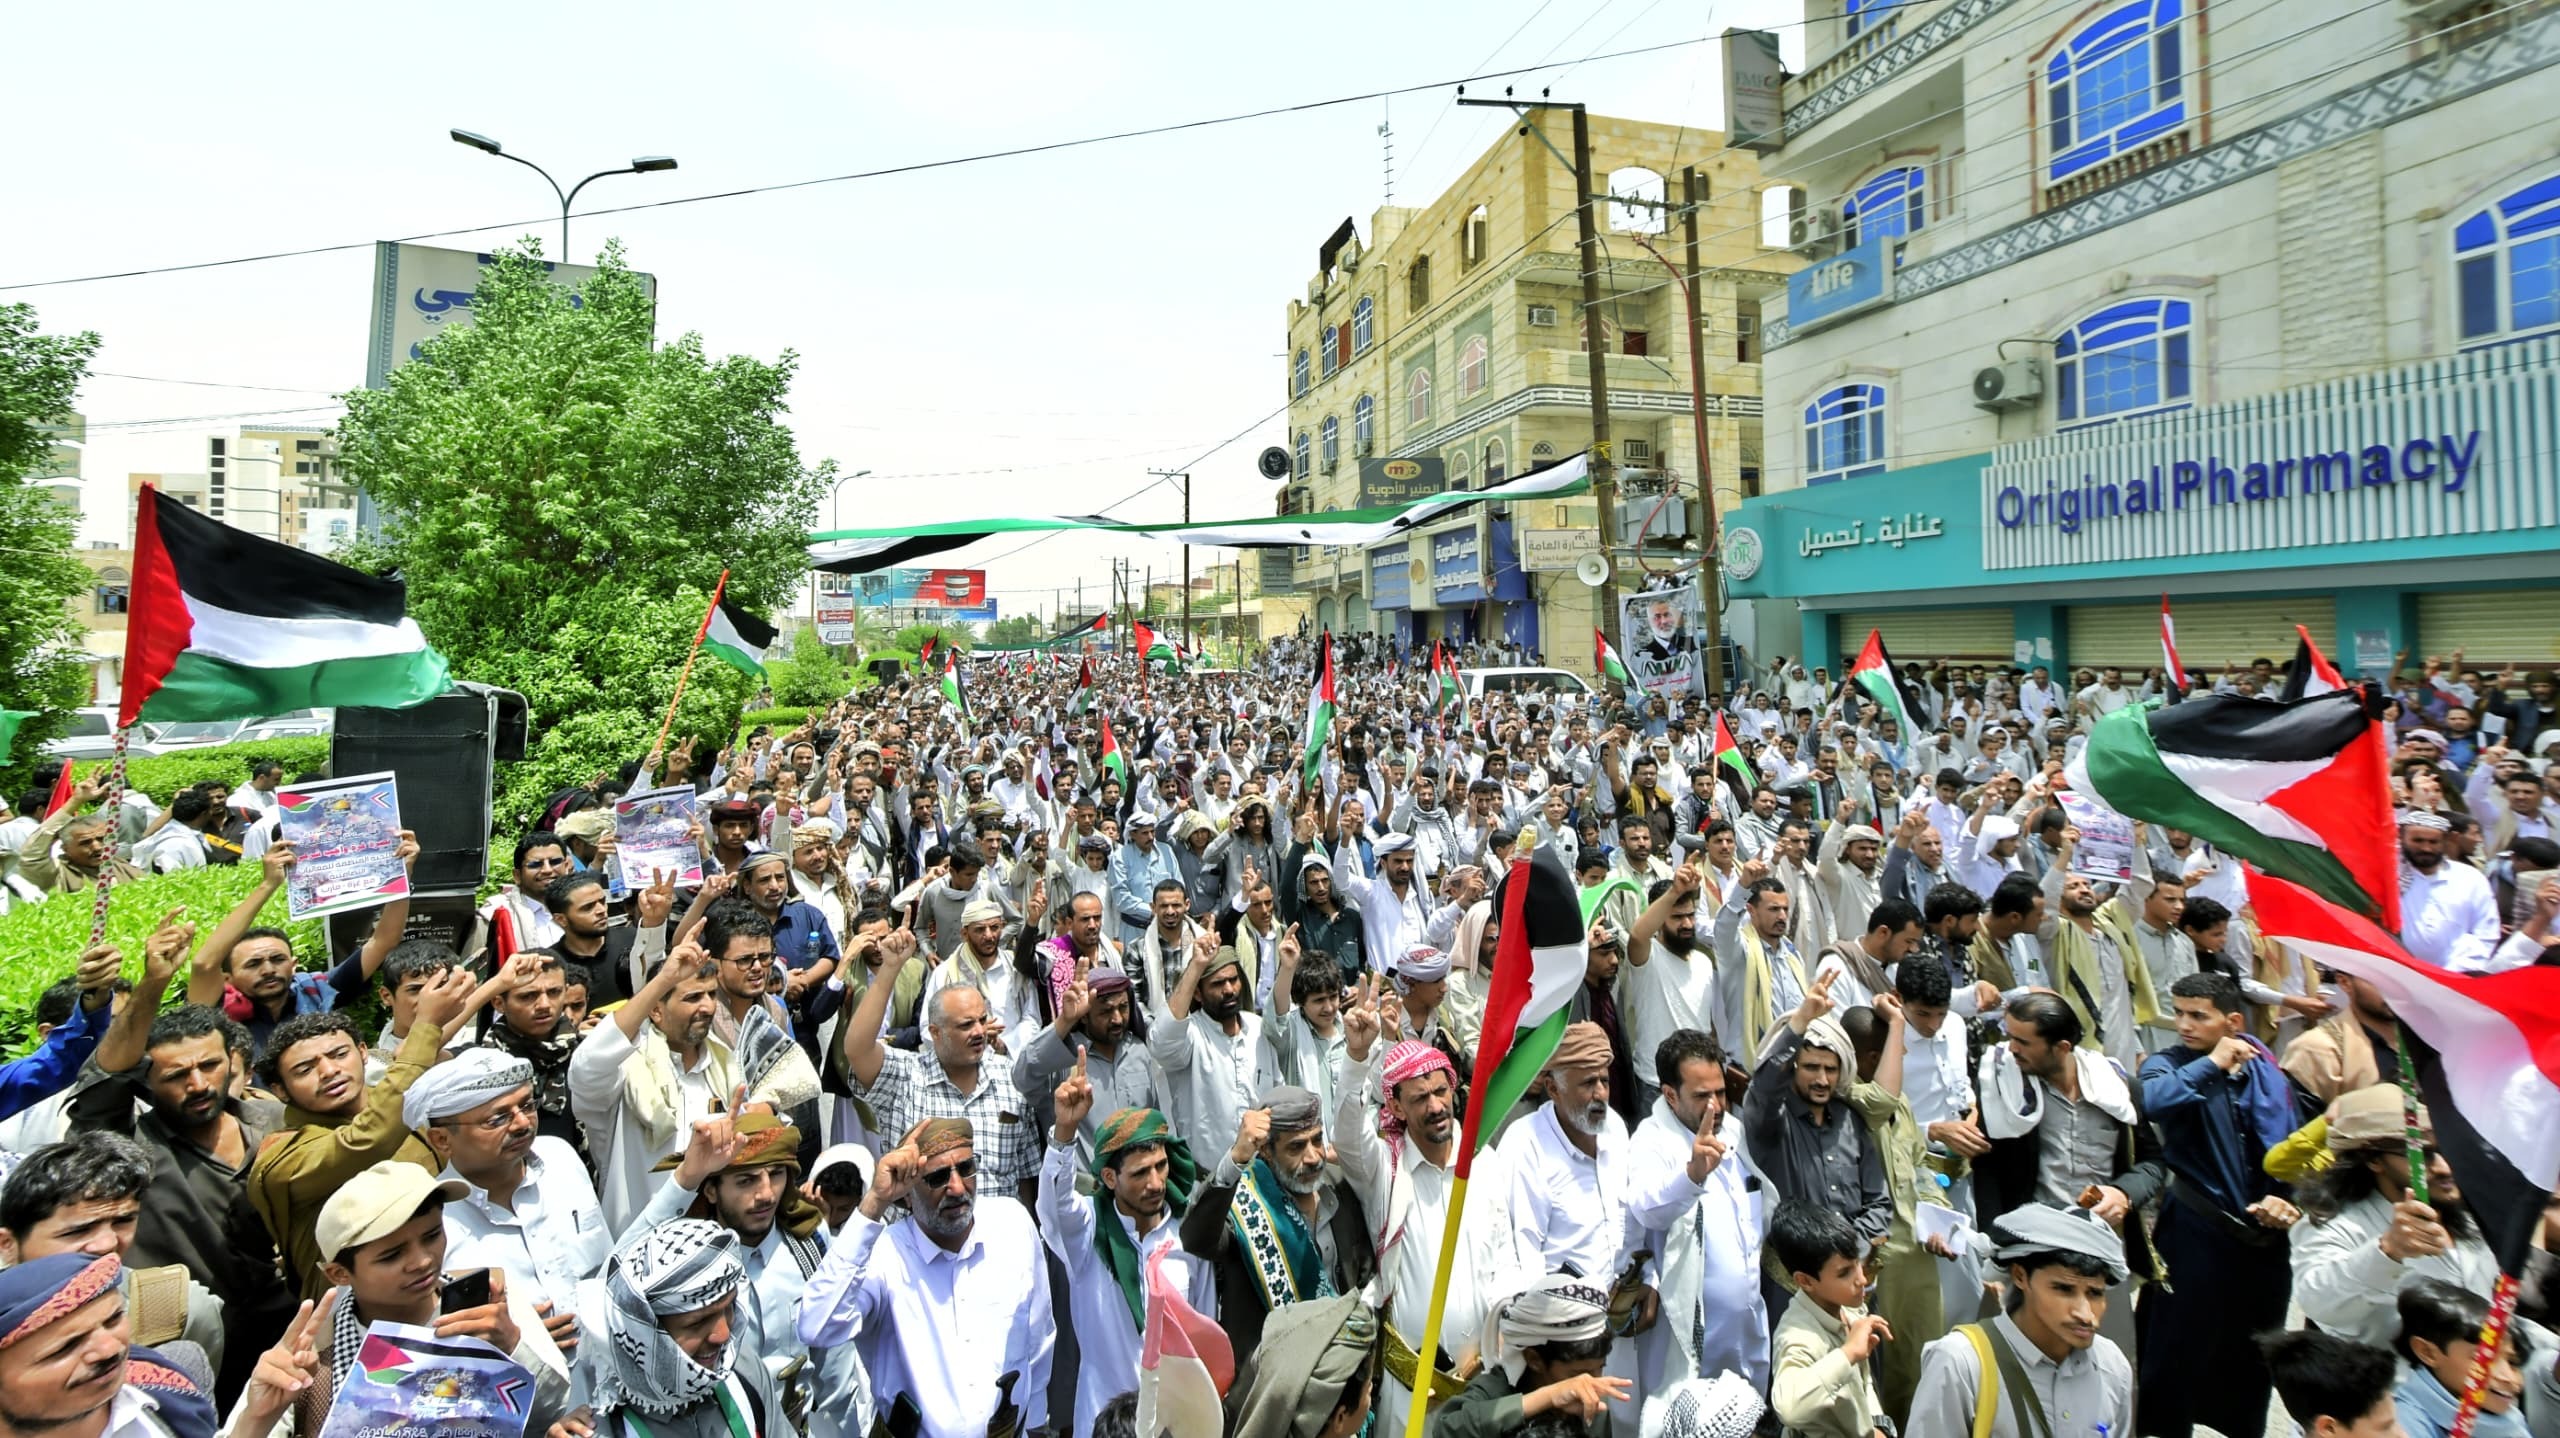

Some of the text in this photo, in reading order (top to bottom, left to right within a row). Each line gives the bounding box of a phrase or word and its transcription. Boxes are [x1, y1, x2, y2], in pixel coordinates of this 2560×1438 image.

[1997, 430, 2482, 534] Original Pharmacy
[1879, 511, 1942, 548] عناية
